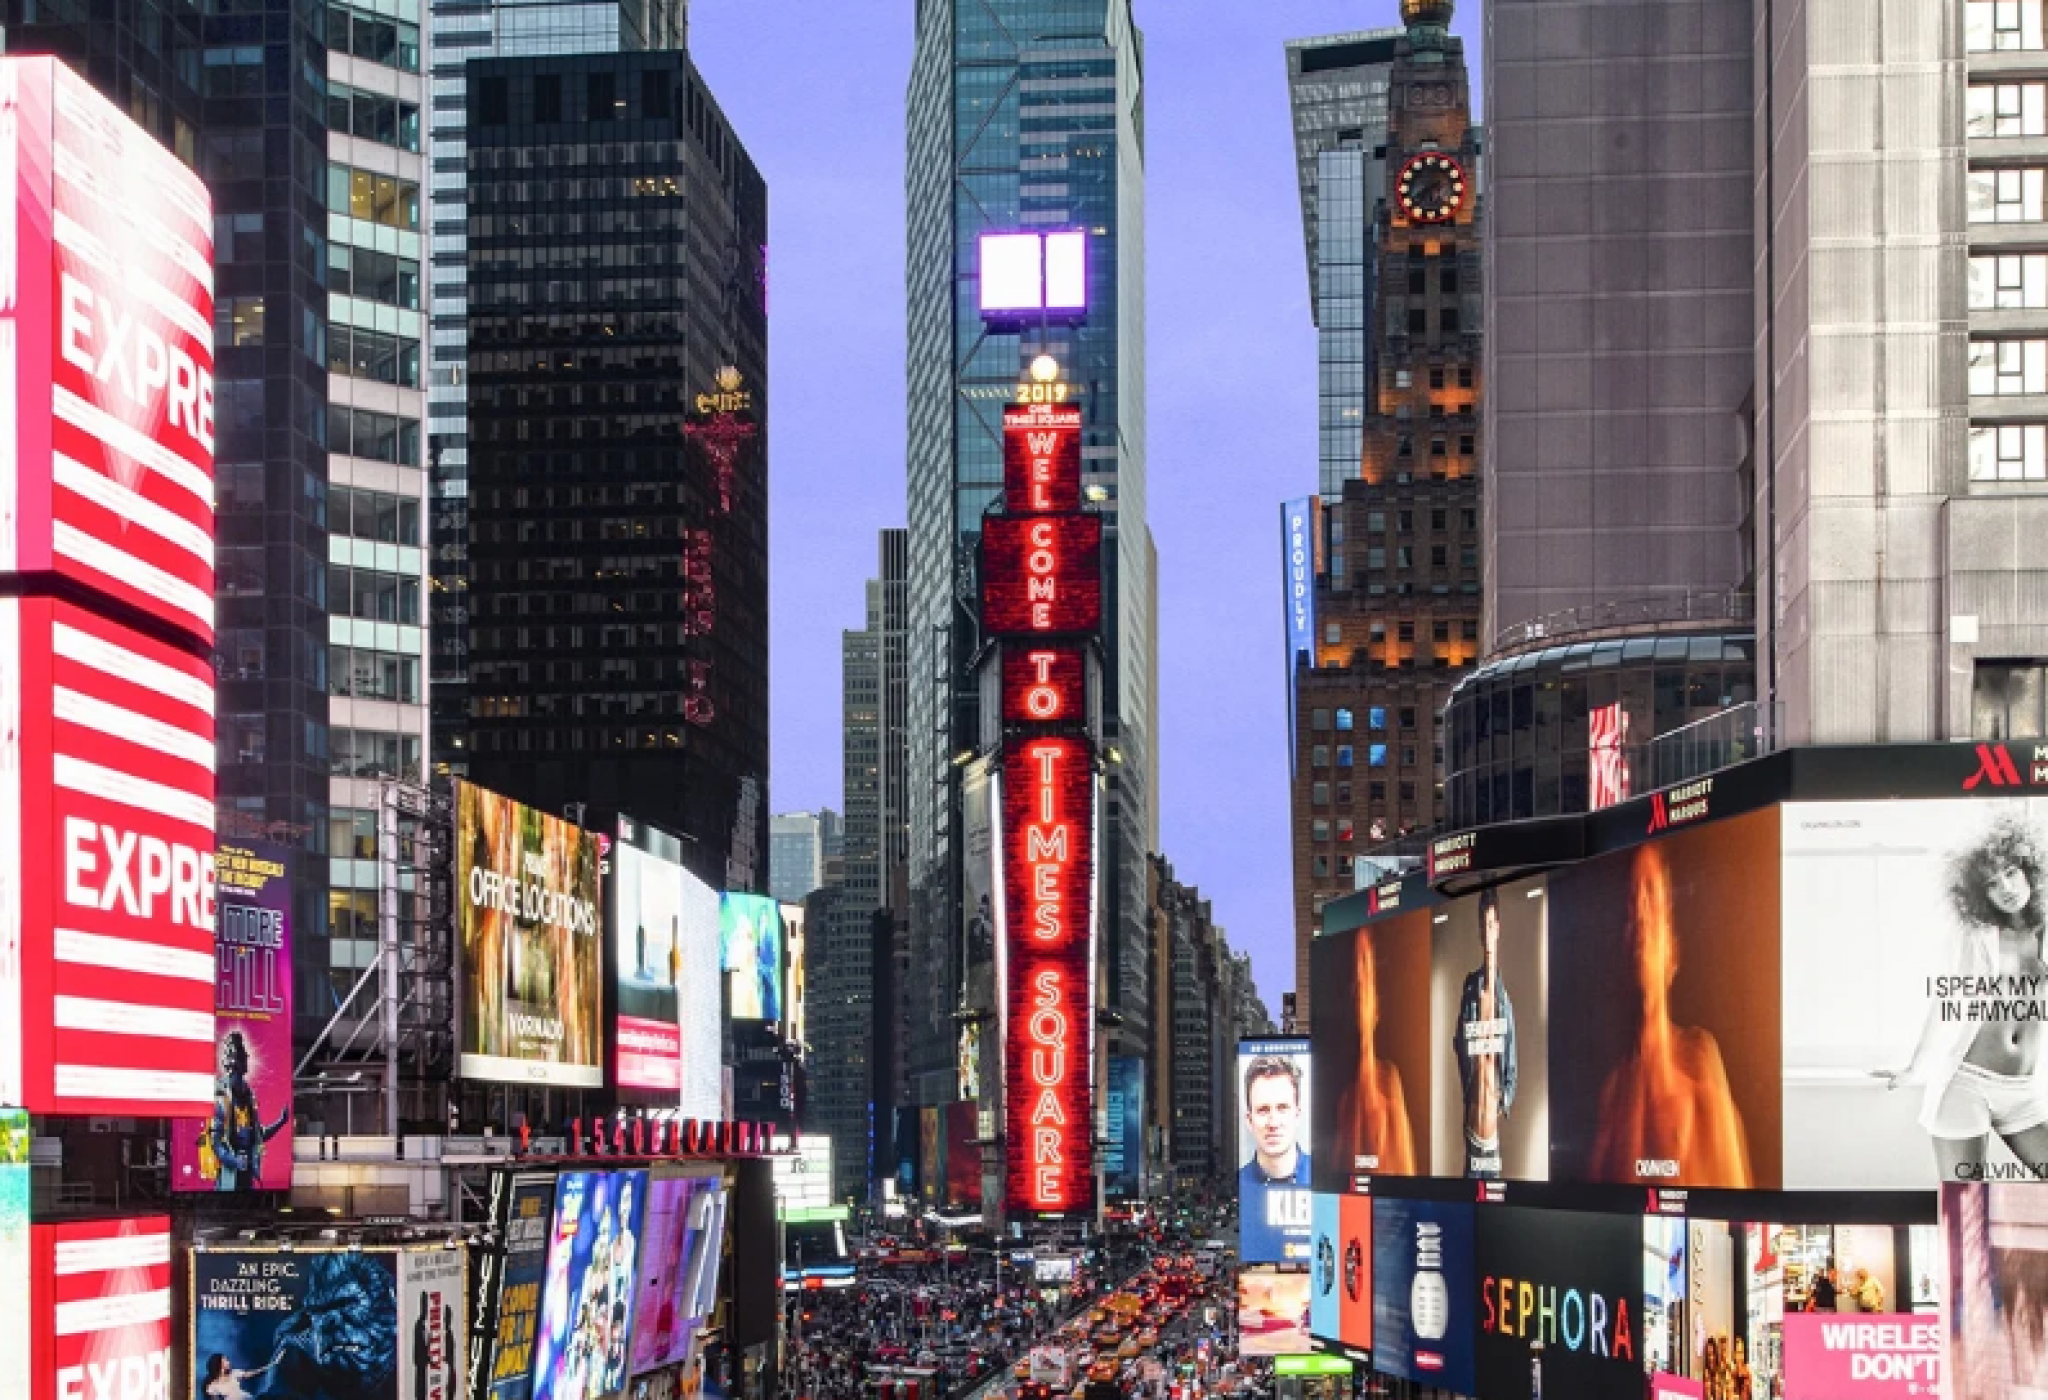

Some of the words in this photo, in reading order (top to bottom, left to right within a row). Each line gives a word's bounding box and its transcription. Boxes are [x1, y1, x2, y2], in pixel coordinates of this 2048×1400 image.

[1017, 384, 1068, 402] 2019
[1027, 432, 1057, 628] WELCOME
[1028, 652, 1058, 718] TO
[1028, 747, 1066, 940] TIMES
[1935, 975, 2003, 998] SPEAK
[2008, 974, 2041, 996] MY
[1941, 1001, 1961, 1021] IN
[1030, 971, 1066, 1204] SQUARE
[1955, 1162, 2026, 1179] CALVIN
[1482, 1275, 1634, 1362] SEPHORA
